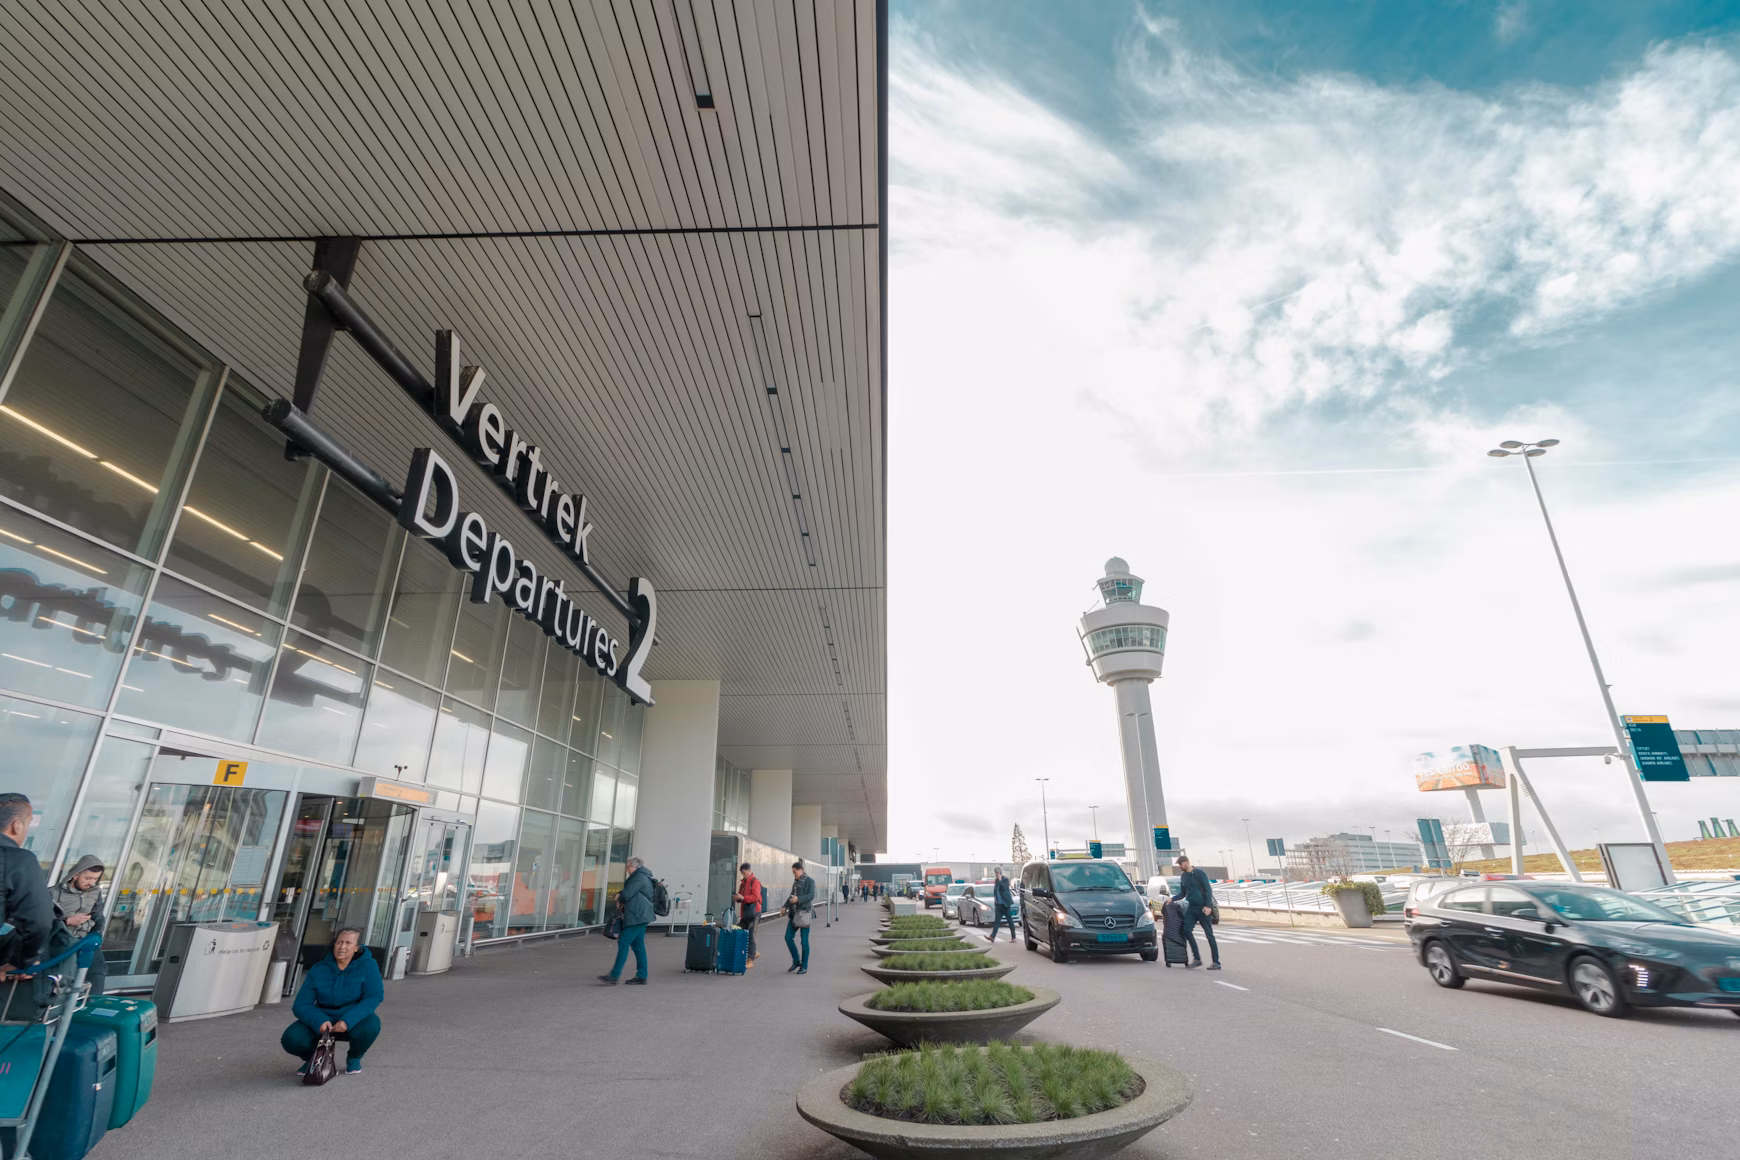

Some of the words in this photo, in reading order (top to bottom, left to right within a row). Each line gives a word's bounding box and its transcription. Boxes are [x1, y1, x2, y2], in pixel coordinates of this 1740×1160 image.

[436, 329, 594, 565] Vertrek
[402, 448, 619, 677] Departures
[618, 577, 657, 703] 2
[223, 764, 240, 782] F
